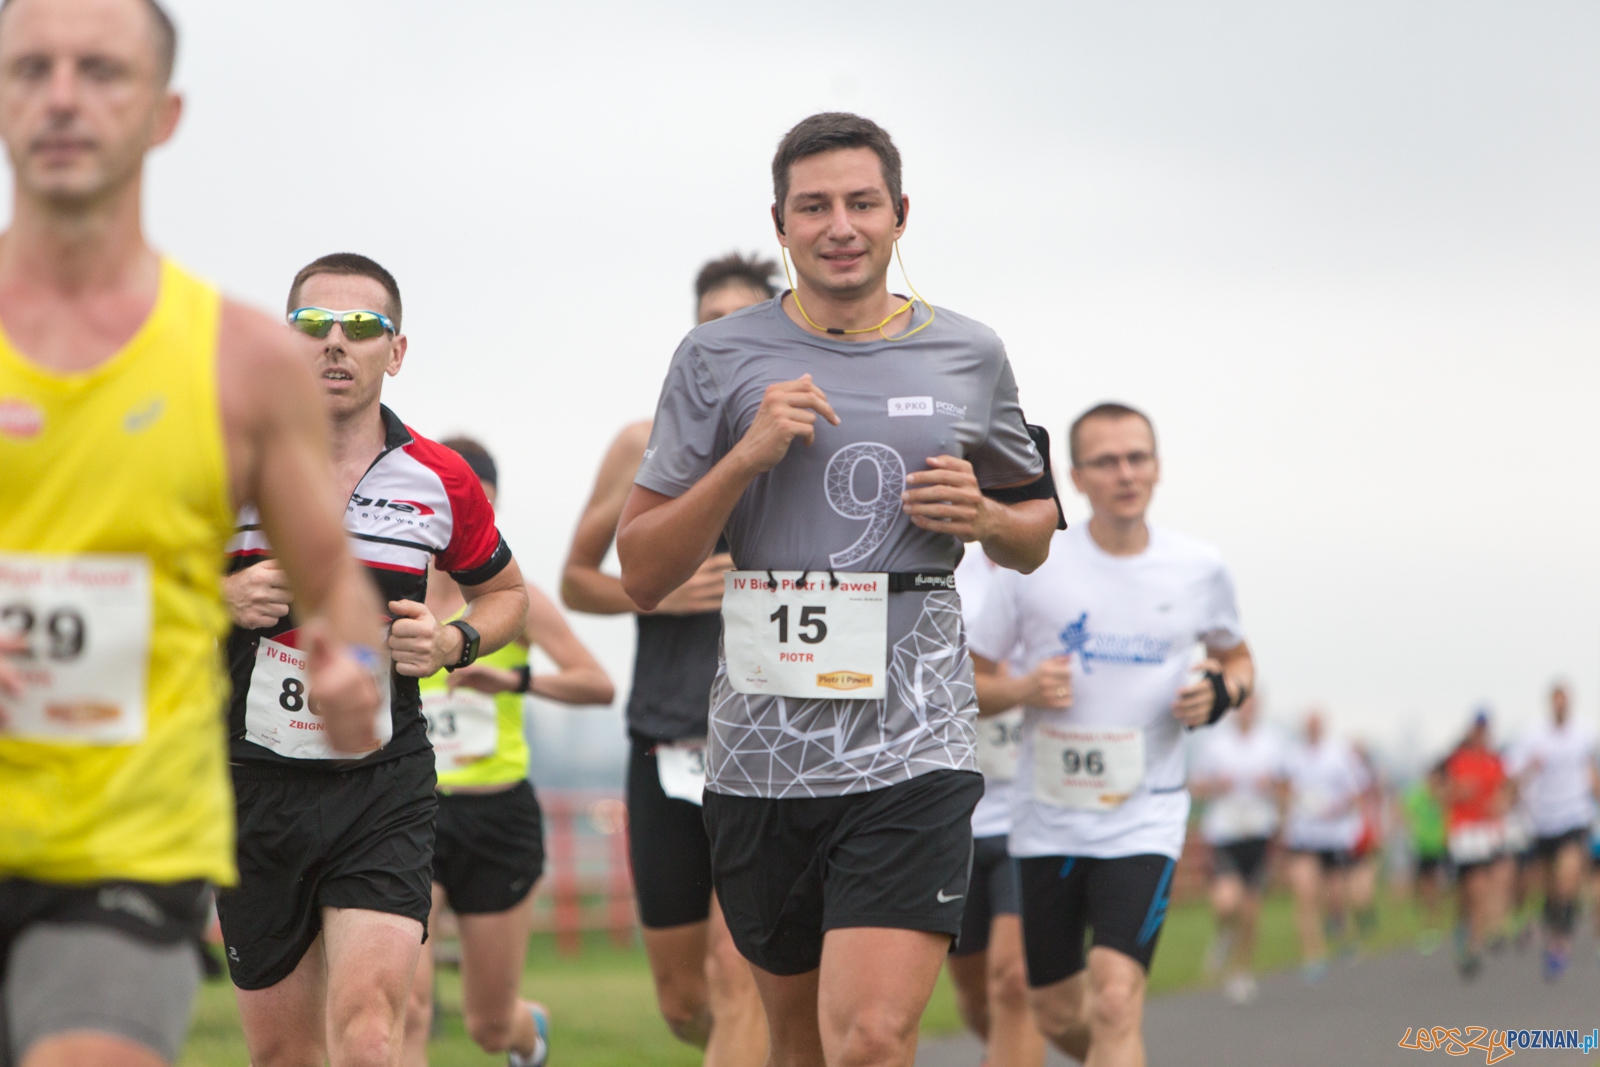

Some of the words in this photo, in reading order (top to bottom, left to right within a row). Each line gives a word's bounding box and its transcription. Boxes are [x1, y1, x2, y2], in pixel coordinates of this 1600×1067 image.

[905, 402, 926, 410] PKO
[824, 441, 906, 569] 9
[734, 578, 746, 589] IV
[750, 579, 777, 592] Bie
[782, 580, 816, 591] Pitr
[821, 579, 825, 590] i
[830, 581, 877, 592] aweł
[770, 605, 827, 644] 15
[266, 646, 278, 659] IV
[280, 652, 306, 671] Bieg
[780, 653, 814, 663] PIOTR
[289, 719, 327, 731] ZBIGN
[1062, 749, 1104, 776] 96
